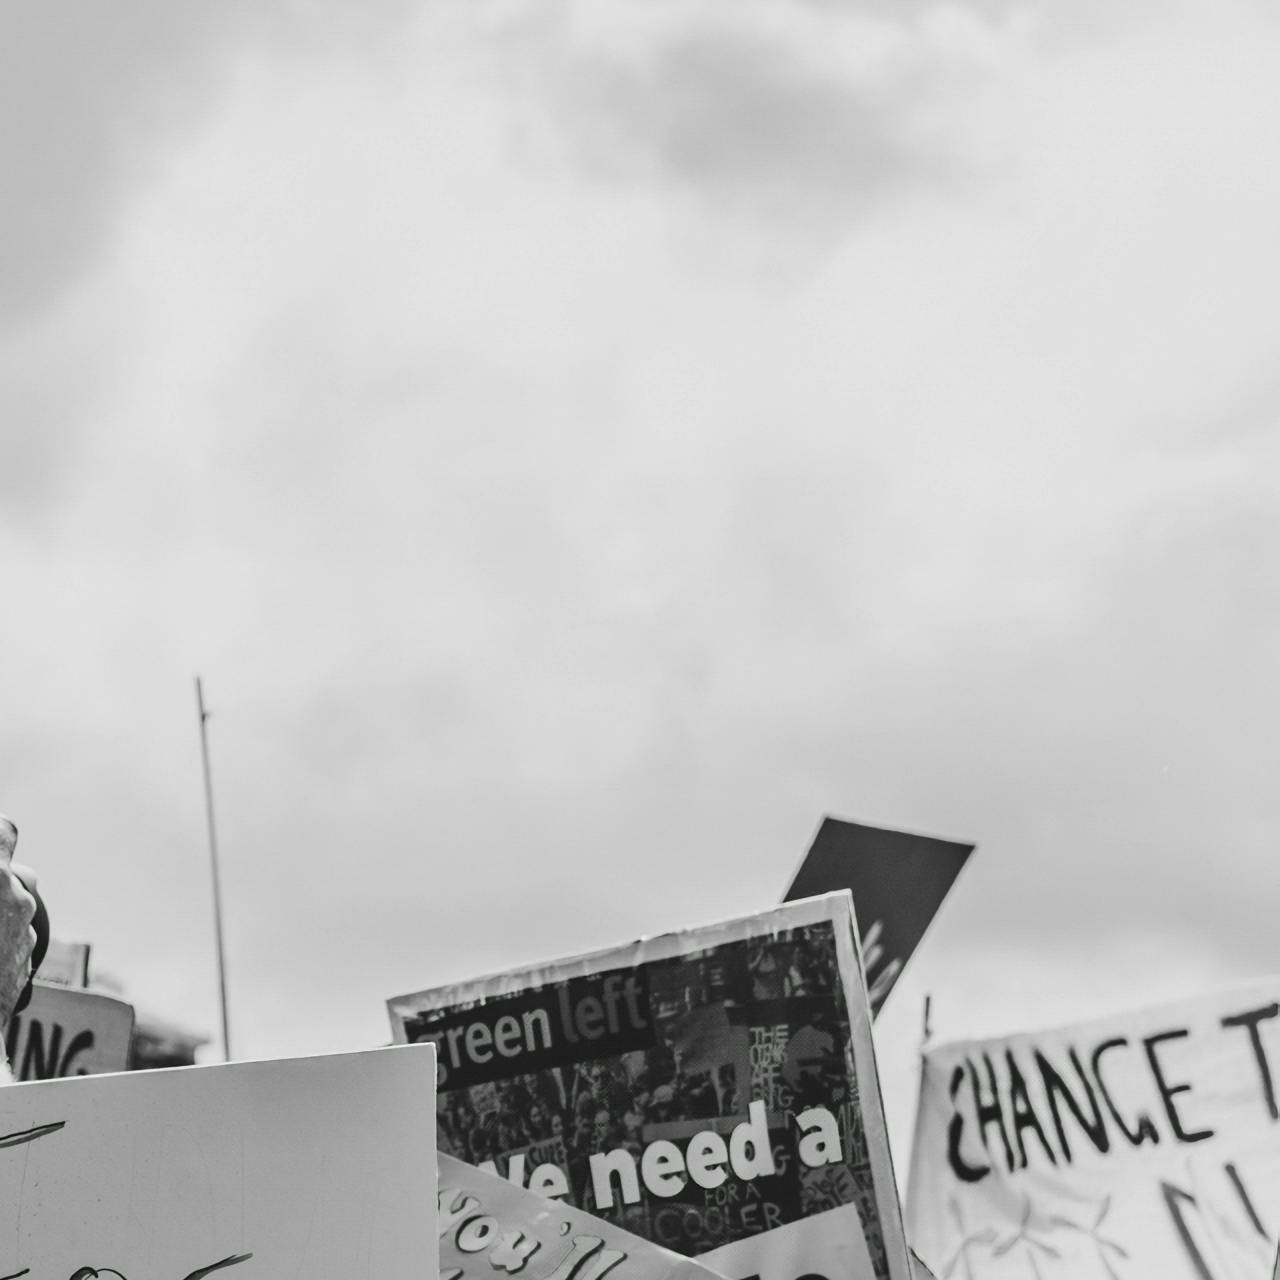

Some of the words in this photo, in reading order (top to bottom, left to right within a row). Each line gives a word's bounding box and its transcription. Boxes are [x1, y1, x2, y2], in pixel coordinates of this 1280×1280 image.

[555, 974, 648, 1044] left
[589, 1100, 776, 1209] need
[796, 1106, 843, 1168] a
[947, 1028, 1215, 1183] CHANGE
